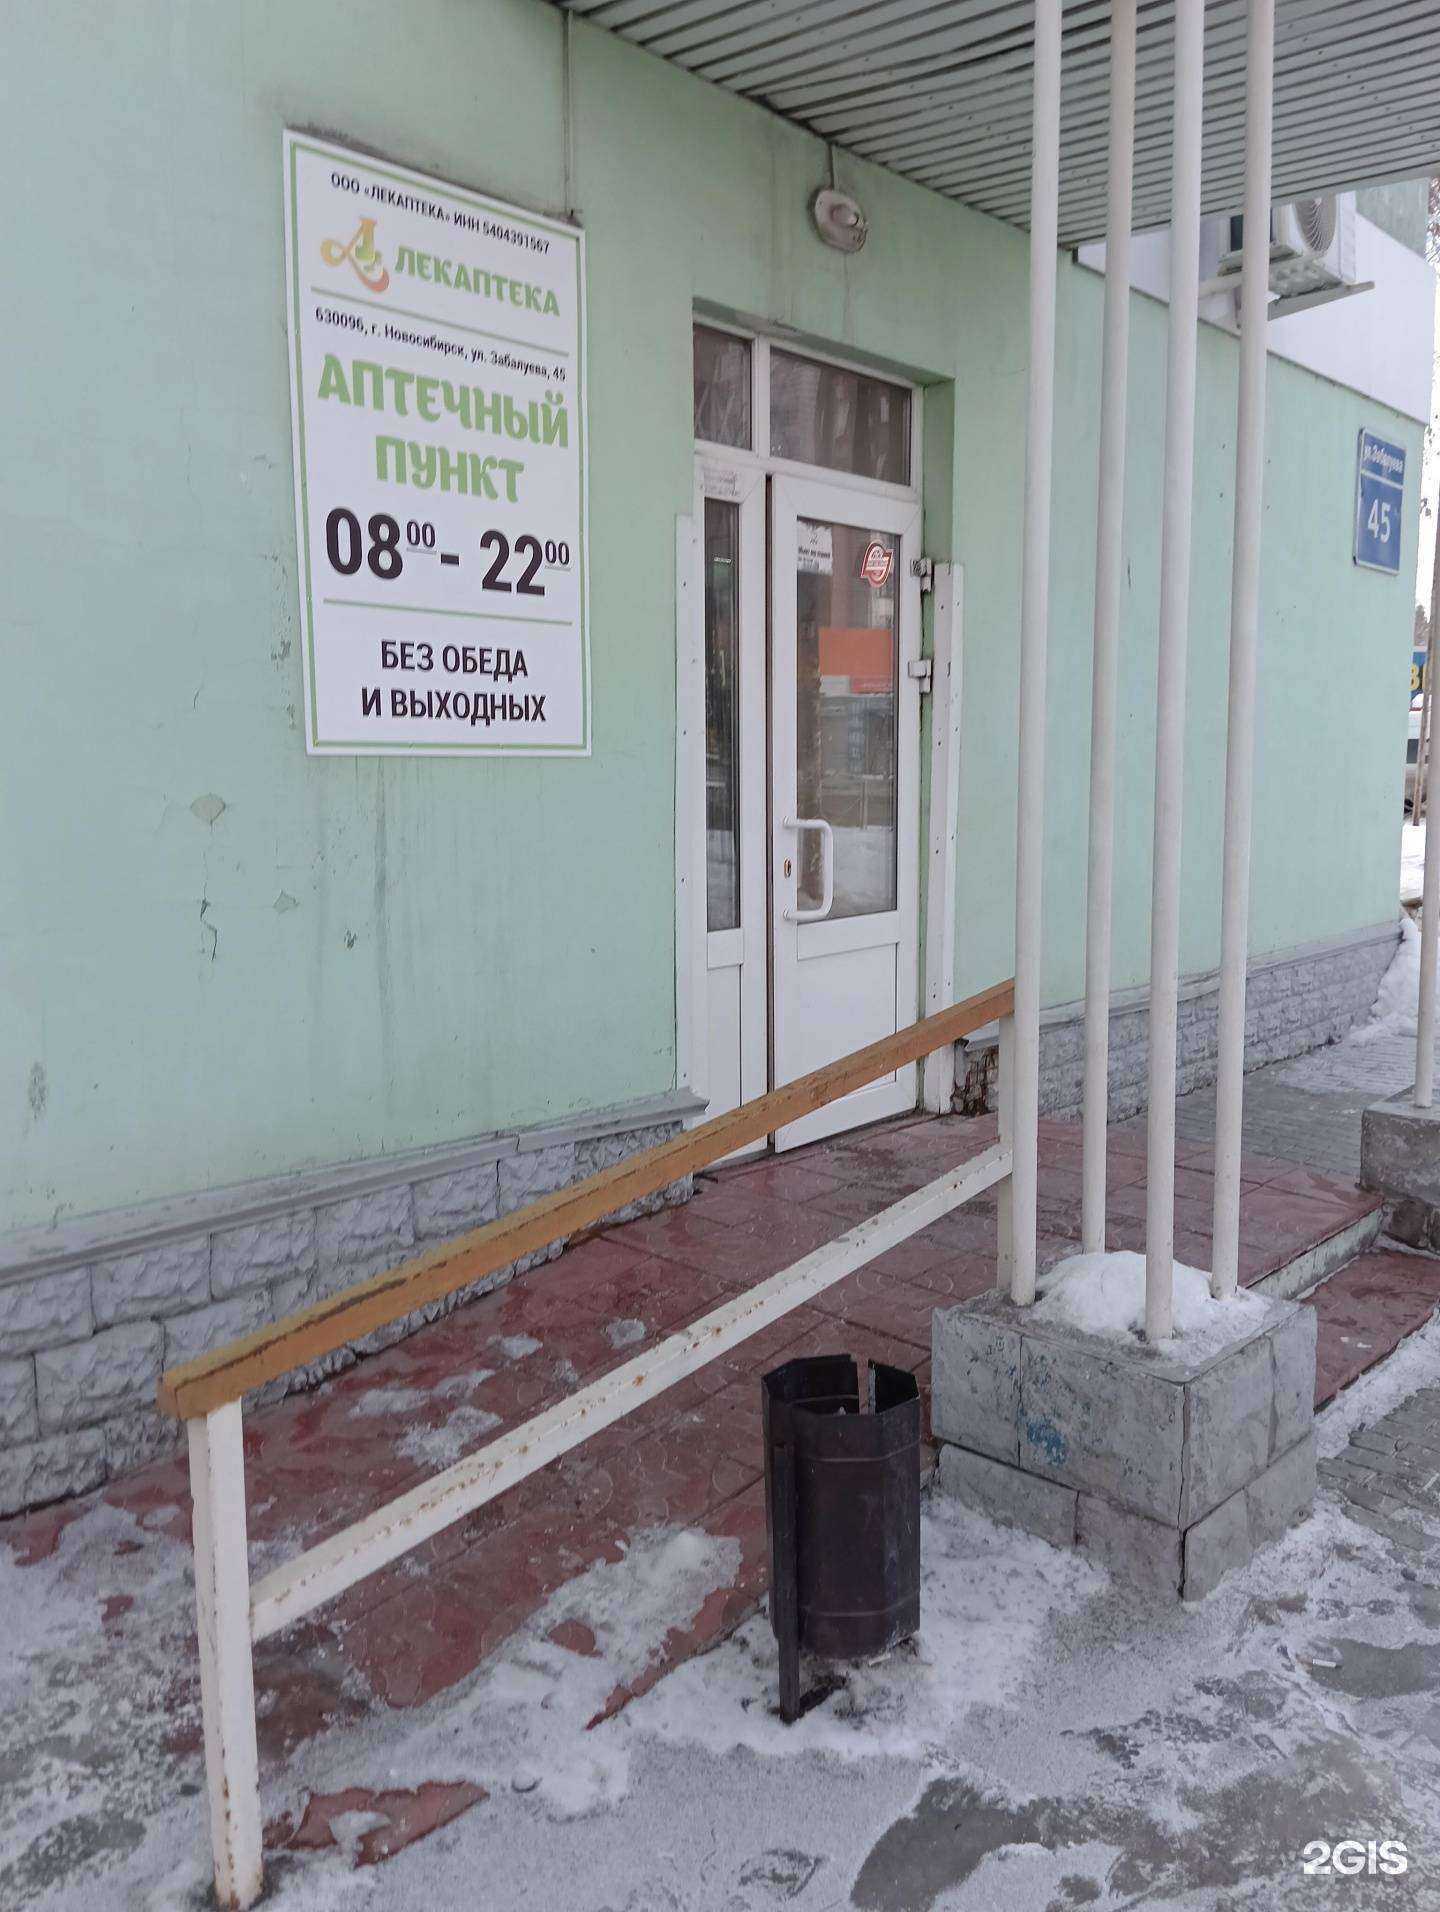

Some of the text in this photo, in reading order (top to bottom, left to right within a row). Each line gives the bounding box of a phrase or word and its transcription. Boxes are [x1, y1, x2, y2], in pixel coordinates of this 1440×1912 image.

[330, 172, 360, 194] ООО
[453, 211, 480, 232] ИНН
[394, 245, 560, 317] ЛЕКАПТЕКА
[384, 325, 468, 359] Новосибирск,
[553, 365, 566, 382] 45
[318, 352, 569, 448] АПТЕЧНЫЙ
[375, 435, 525, 503] ПУНКТ
[1367, 498, 1391, 544] 45
[380, 638, 529, 683] БЕЗ ОБЕДА
[360, 687, 547, 727] И ВЫХОДНЫХ
